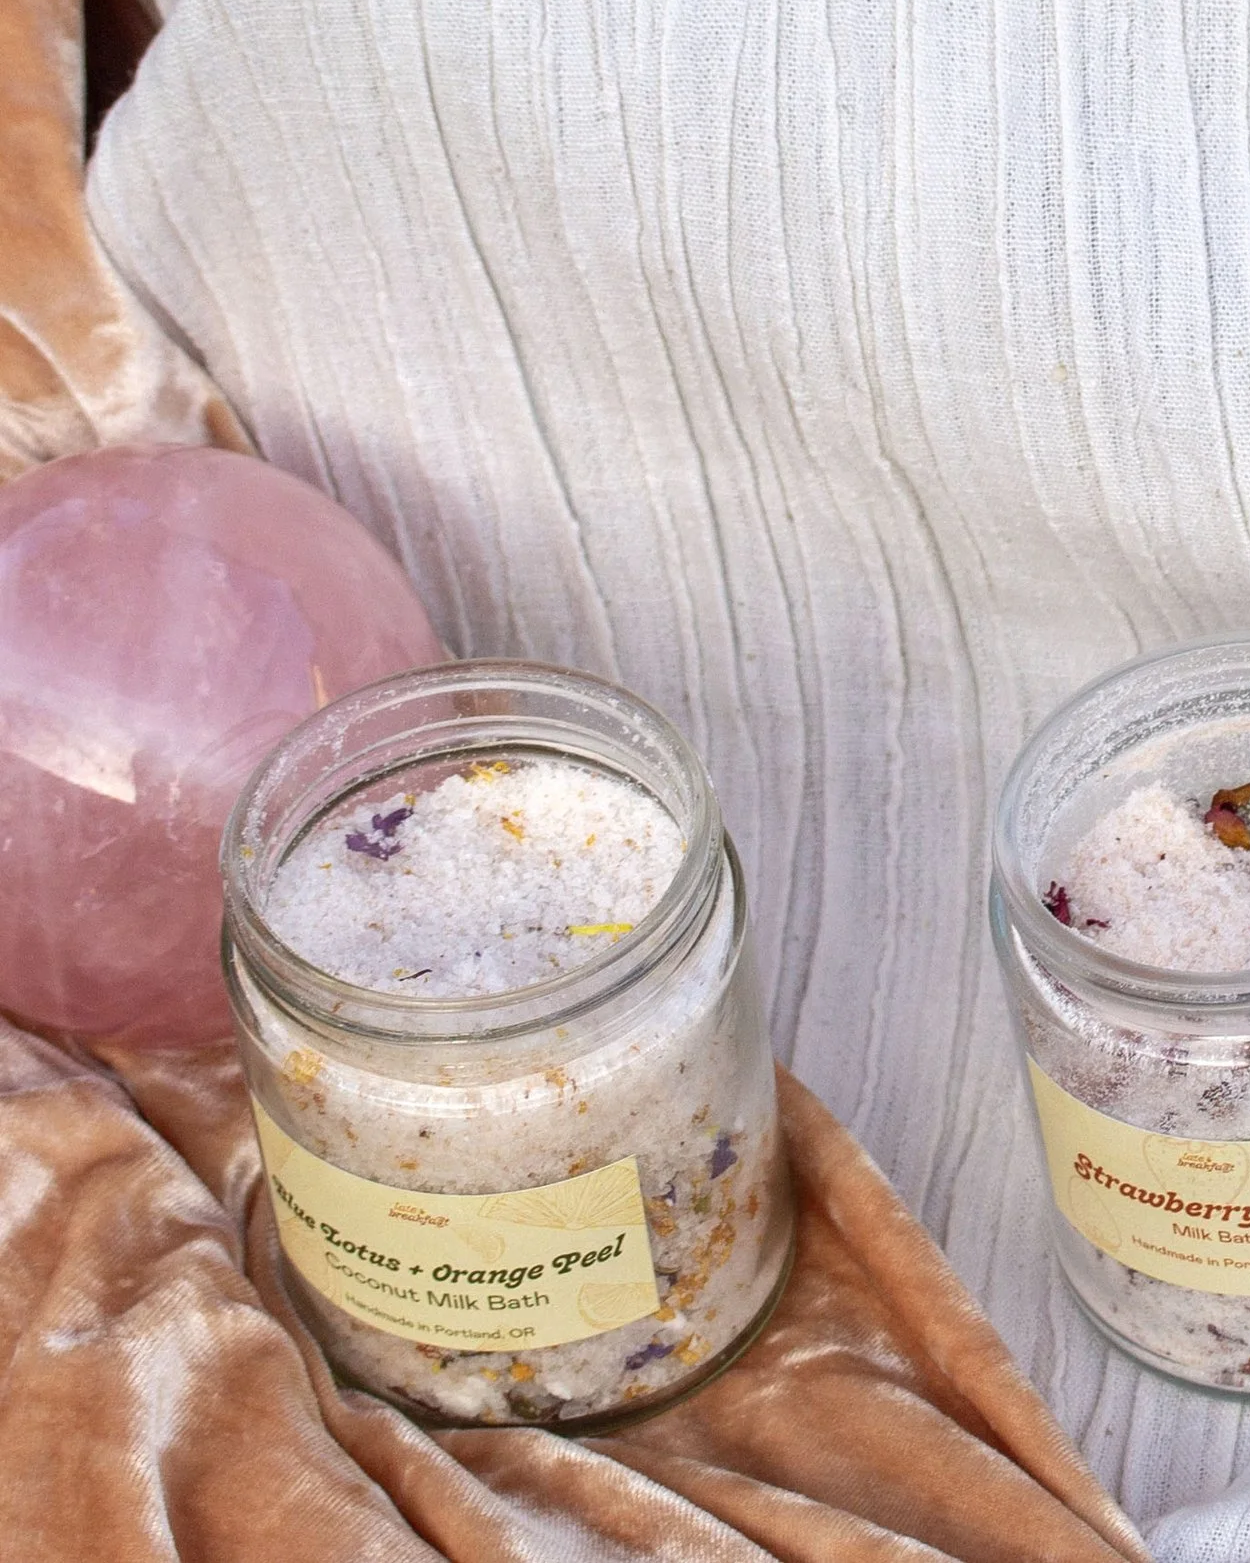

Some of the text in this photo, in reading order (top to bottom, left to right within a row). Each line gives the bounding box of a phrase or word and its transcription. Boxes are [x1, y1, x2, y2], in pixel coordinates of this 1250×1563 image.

[271, 1173, 626, 1288] Blue Lotus + Orange Peel
[1131, 1235, 1203, 1265] Handmade
[1206, 1257, 1220, 1267] in
[1173, 1223, 1212, 1242] Milk
[324, 1251, 550, 1311] Coconut Milk Bath
[345, 1291, 536, 1340] Handmade in Portland, OR
